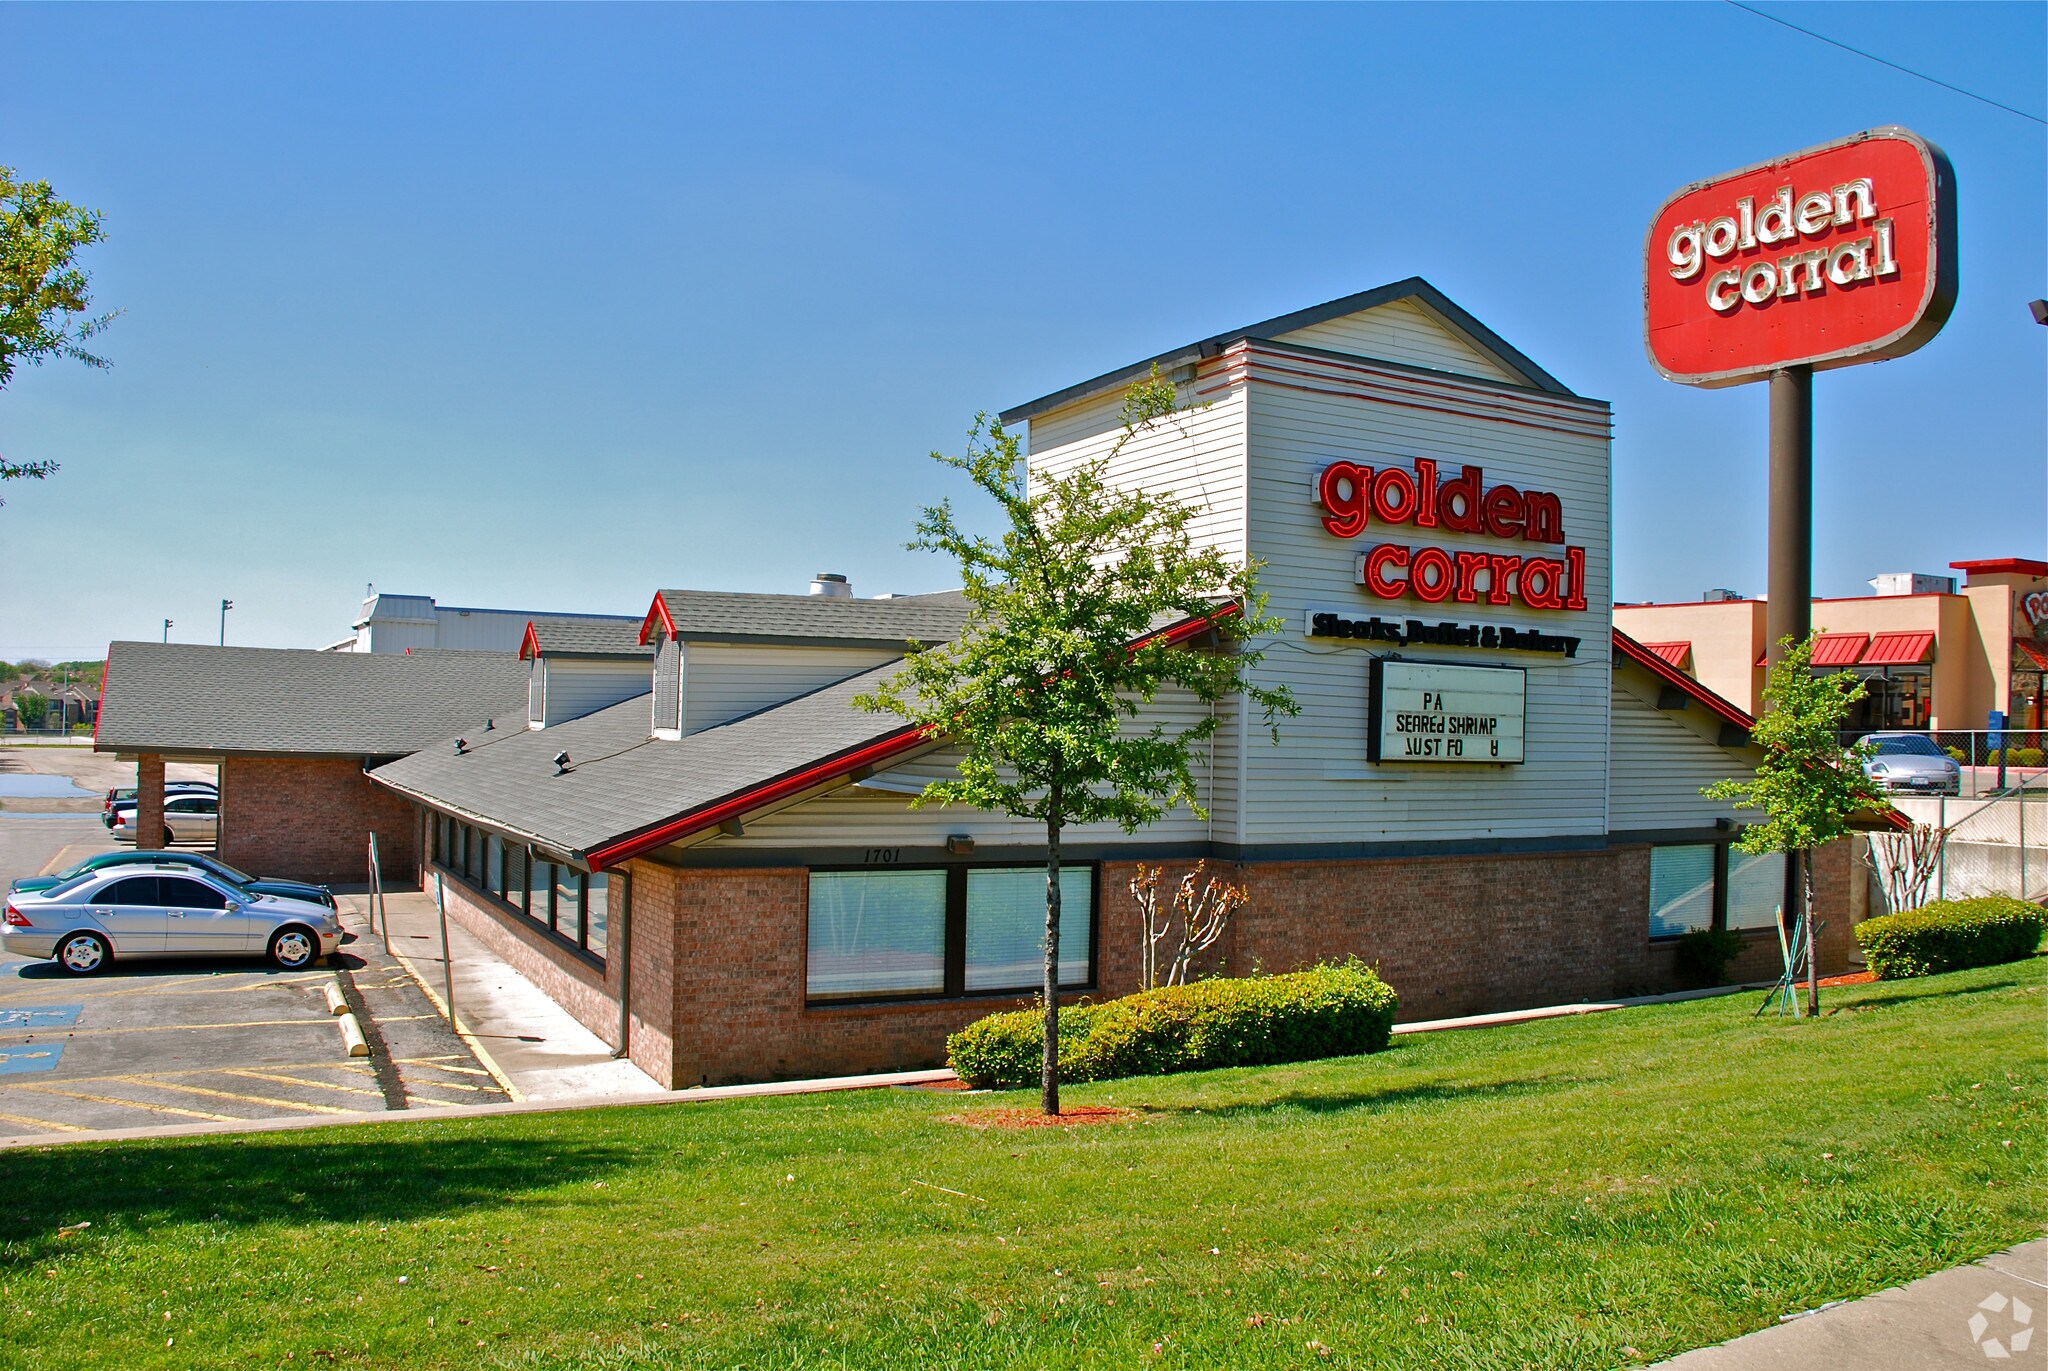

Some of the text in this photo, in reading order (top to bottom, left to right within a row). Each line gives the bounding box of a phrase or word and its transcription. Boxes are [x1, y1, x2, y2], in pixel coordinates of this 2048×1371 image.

[1667, 177, 1877, 280] golden
[1706, 217, 1897, 311] corral
[1319, 457, 1565, 544] golden
[1364, 543, 1587, 611] corral
[1407, 620, 1480, 648] Buffet
[1480, 625, 1500, 648] &
[1500, 627, 1581, 658] Bakery
[1448, 716, 1497, 735] SHRIMP
[864, 848, 900, 863] 1701
